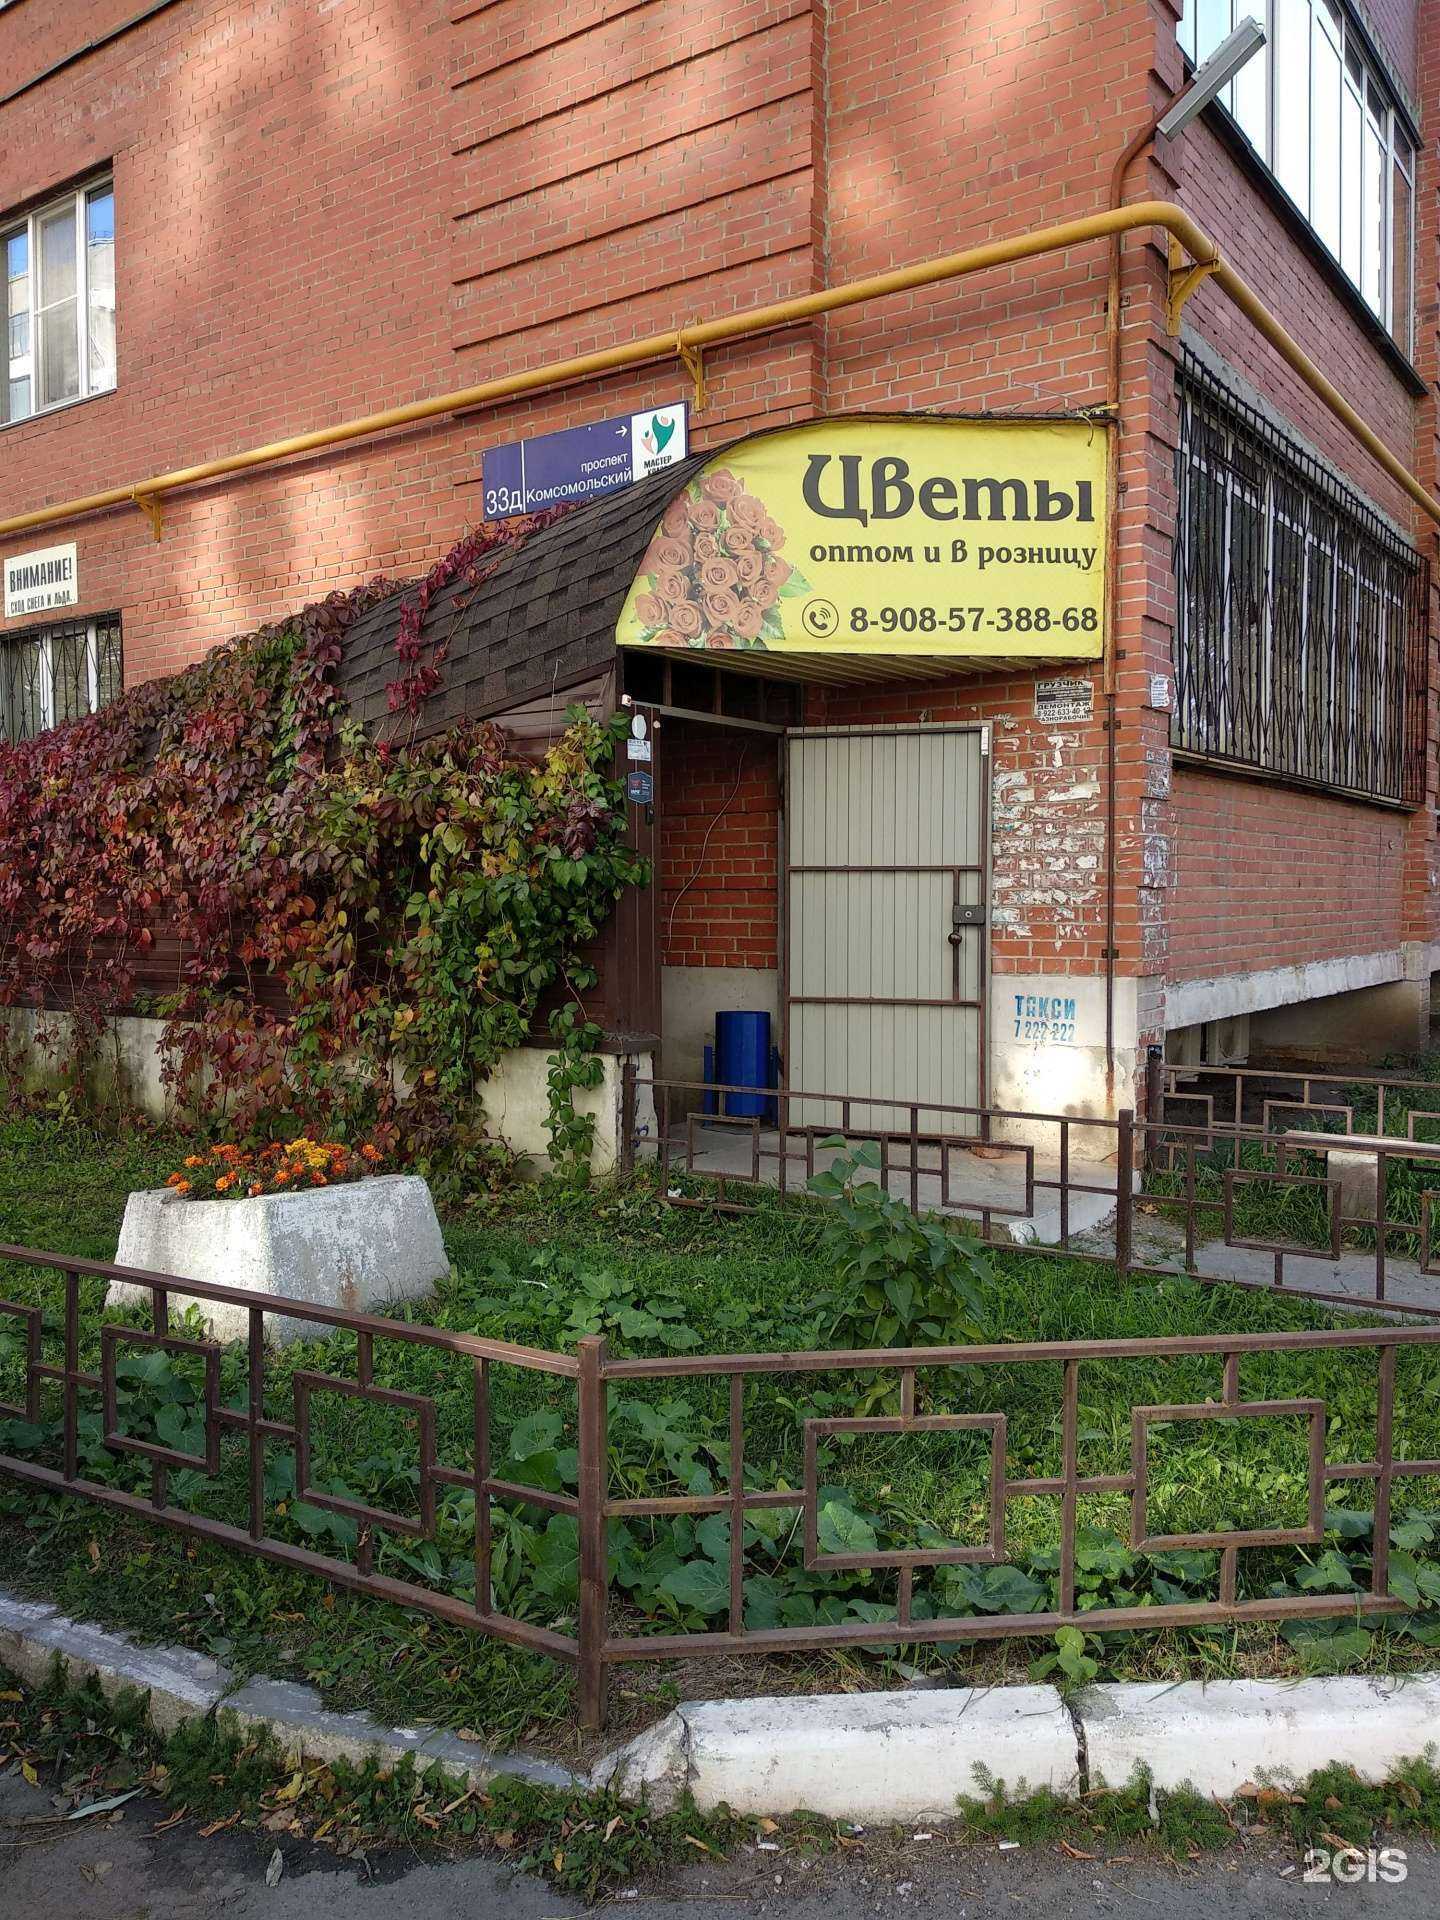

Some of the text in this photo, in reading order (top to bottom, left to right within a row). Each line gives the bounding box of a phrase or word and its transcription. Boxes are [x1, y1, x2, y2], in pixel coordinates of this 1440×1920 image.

[581, 452, 628, 473] проспект
[644, 456, 672, 469] МАСТЕР
[526, 468, 632, 504] Комсомольский
[802, 454, 1095, 527] Цветы
[486, 486, 523, 514] 33д
[810, 540, 1097, 570] оптом и в розницу
[9, 557, 72, 592] ВНИМАНИЕ!
[10, 599, 25, 614] СХОД
[27, 595, 45, 610] СНЕГА
[47, 593, 52, 606] И
[850, 607, 1098, 632] 8-908-57-388-68
[1038, 702, 1090, 710] ДЕМОНТАЖ
[1014, 996, 1075, 1020] ТАКСИ
